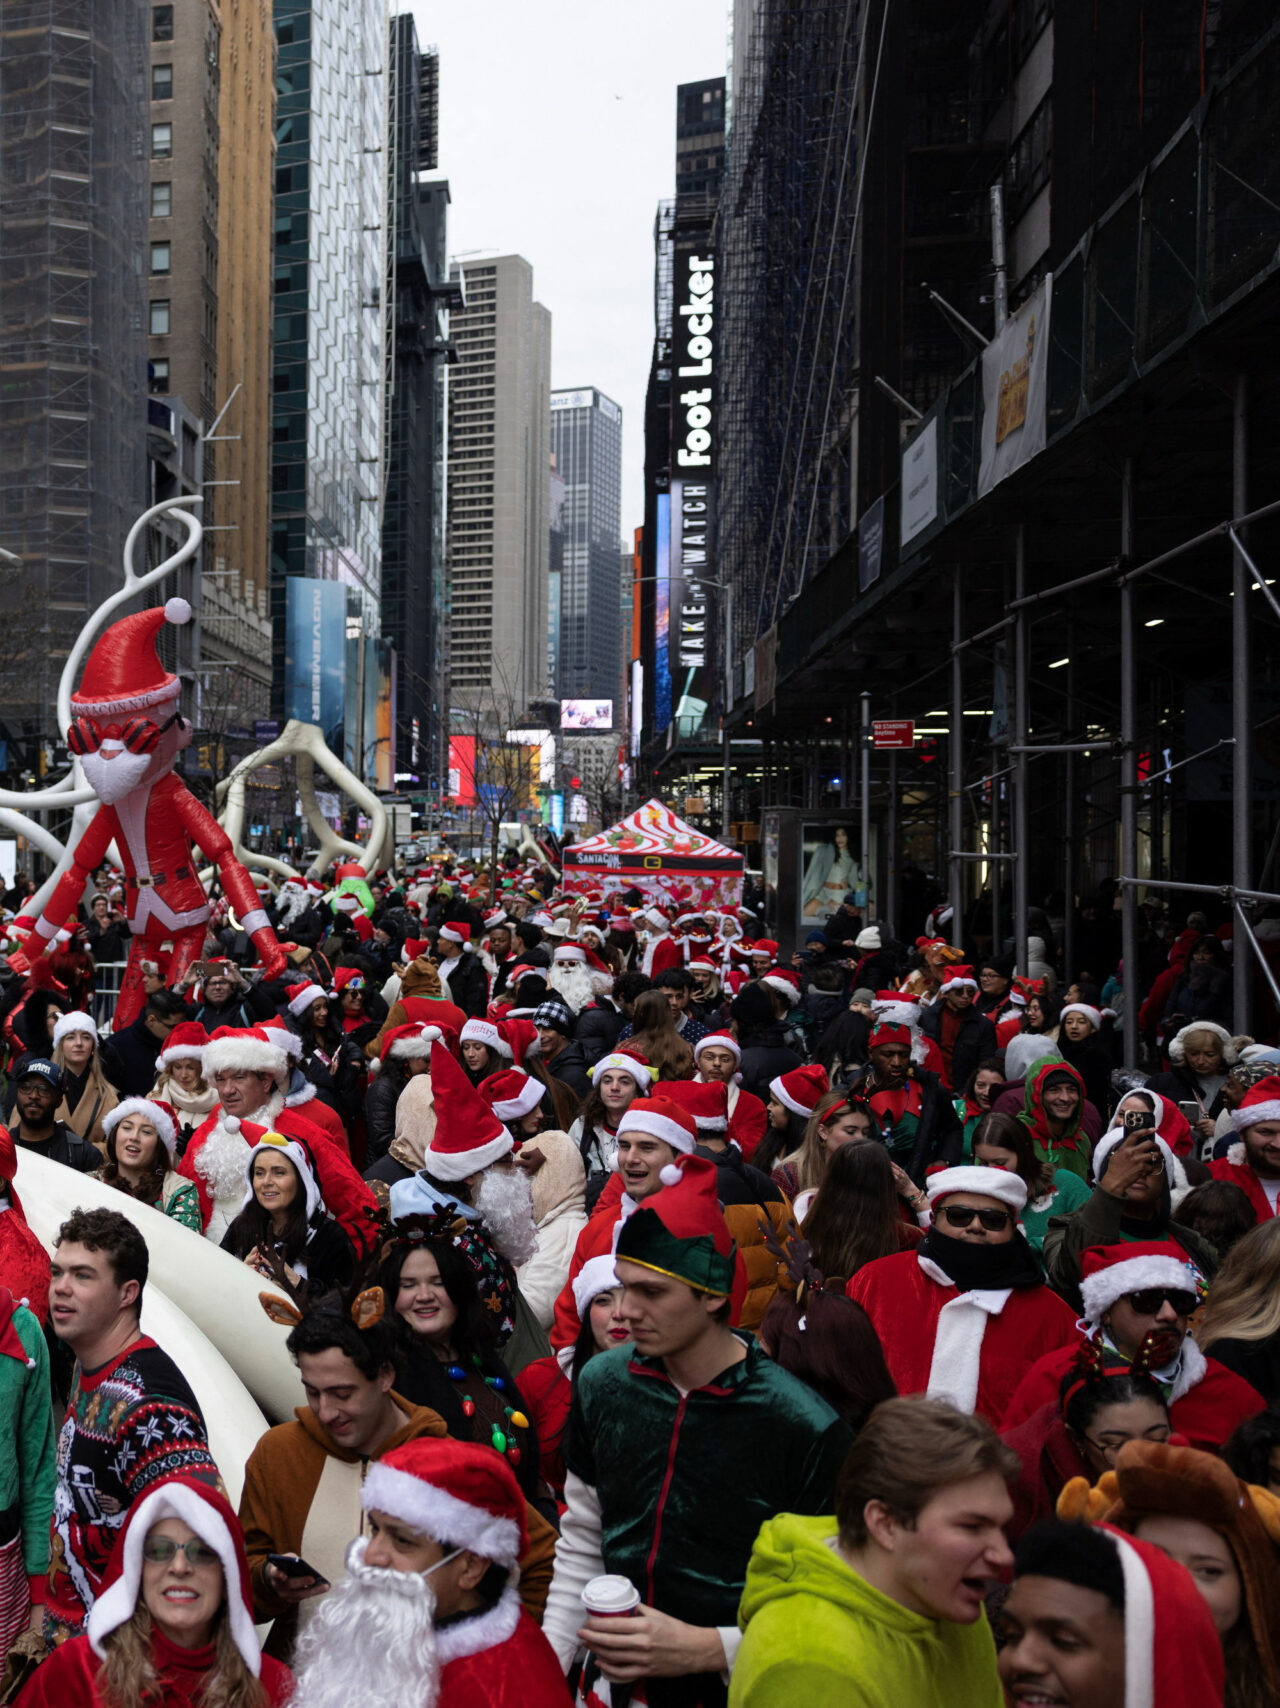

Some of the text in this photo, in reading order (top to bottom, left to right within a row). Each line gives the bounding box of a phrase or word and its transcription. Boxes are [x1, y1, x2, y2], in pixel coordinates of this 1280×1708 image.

[677, 254, 714, 467] Foot Locker
[682, 484, 707, 565] WATCH
[312, 588, 321, 721] NOVEMBER
[546, 642, 556, 698] SQUAR
[681, 604, 705, 667] MAKE
